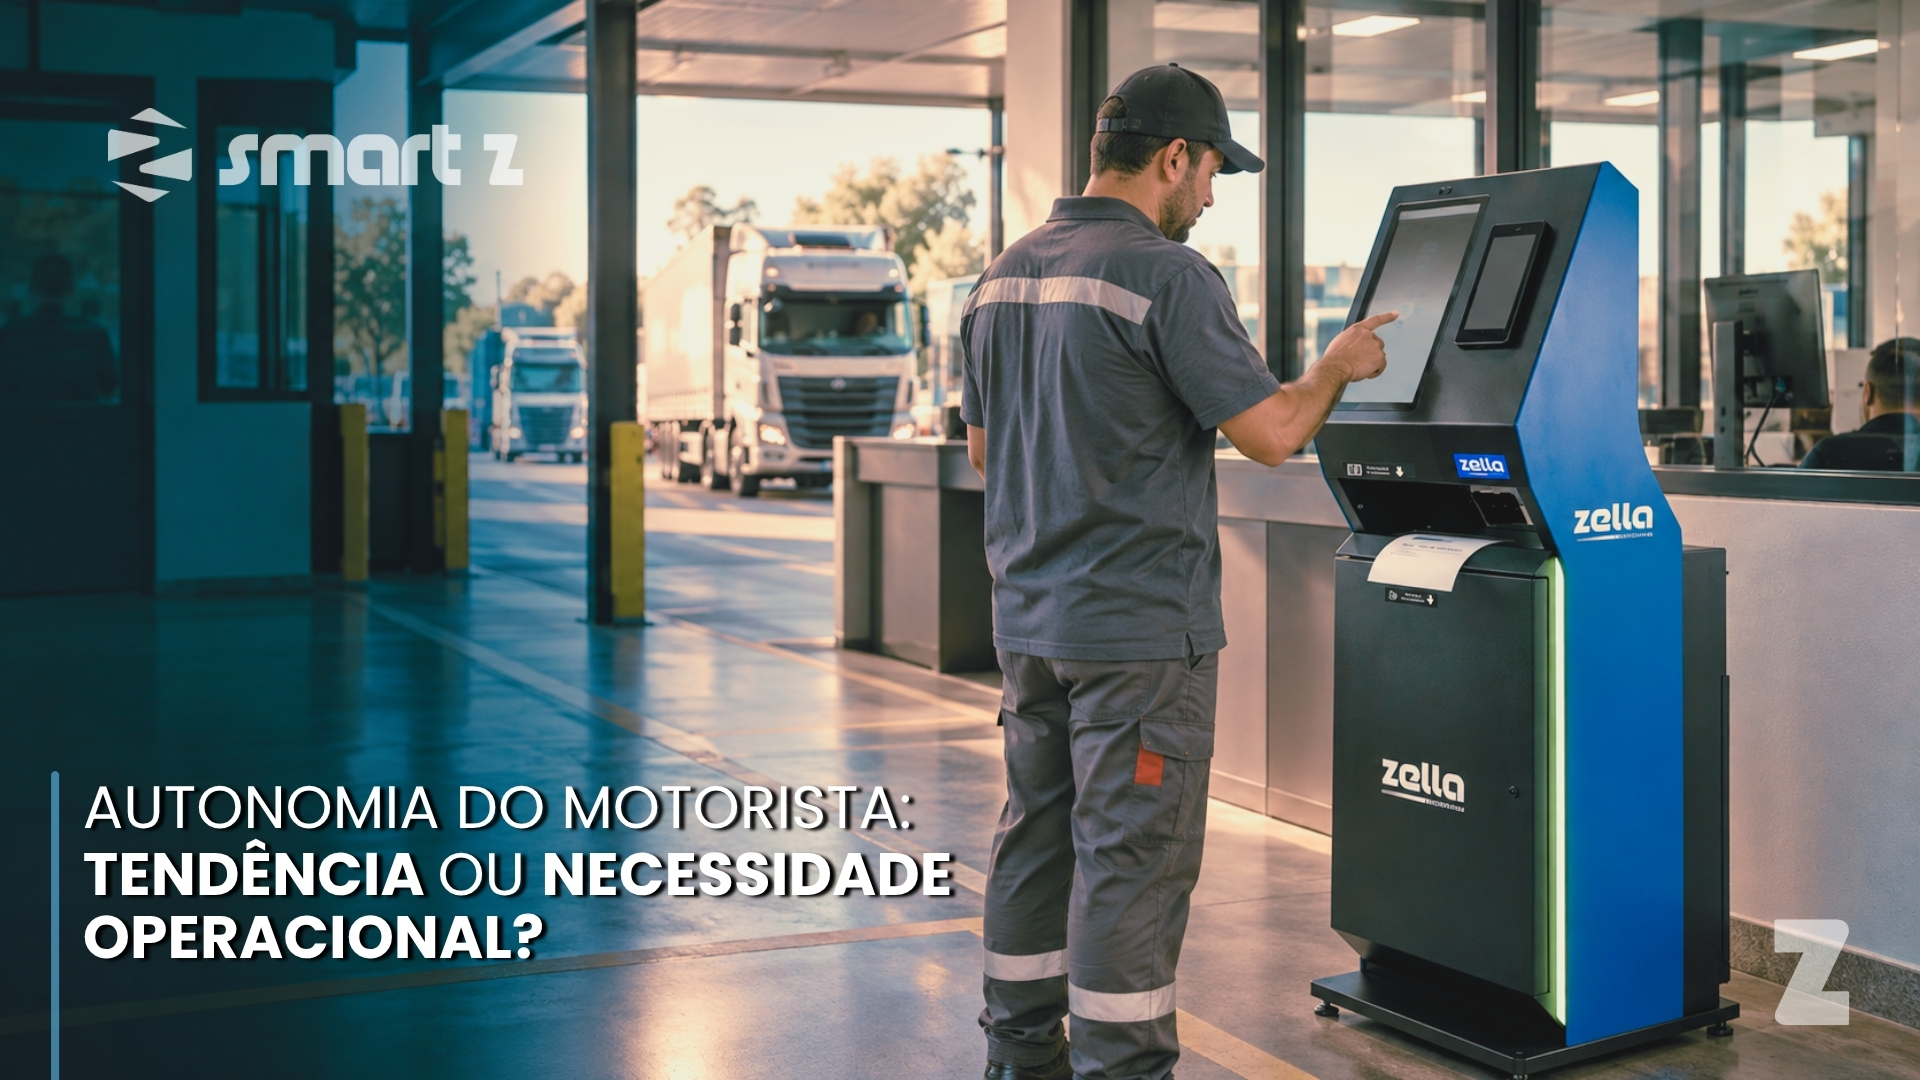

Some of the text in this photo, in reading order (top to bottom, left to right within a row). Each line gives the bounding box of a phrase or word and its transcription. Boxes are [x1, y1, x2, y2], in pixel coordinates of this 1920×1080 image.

[1459, 456, 1505, 473] zella
[1573, 502, 1654, 534] zella
[1381, 758, 1465, 803] zella
